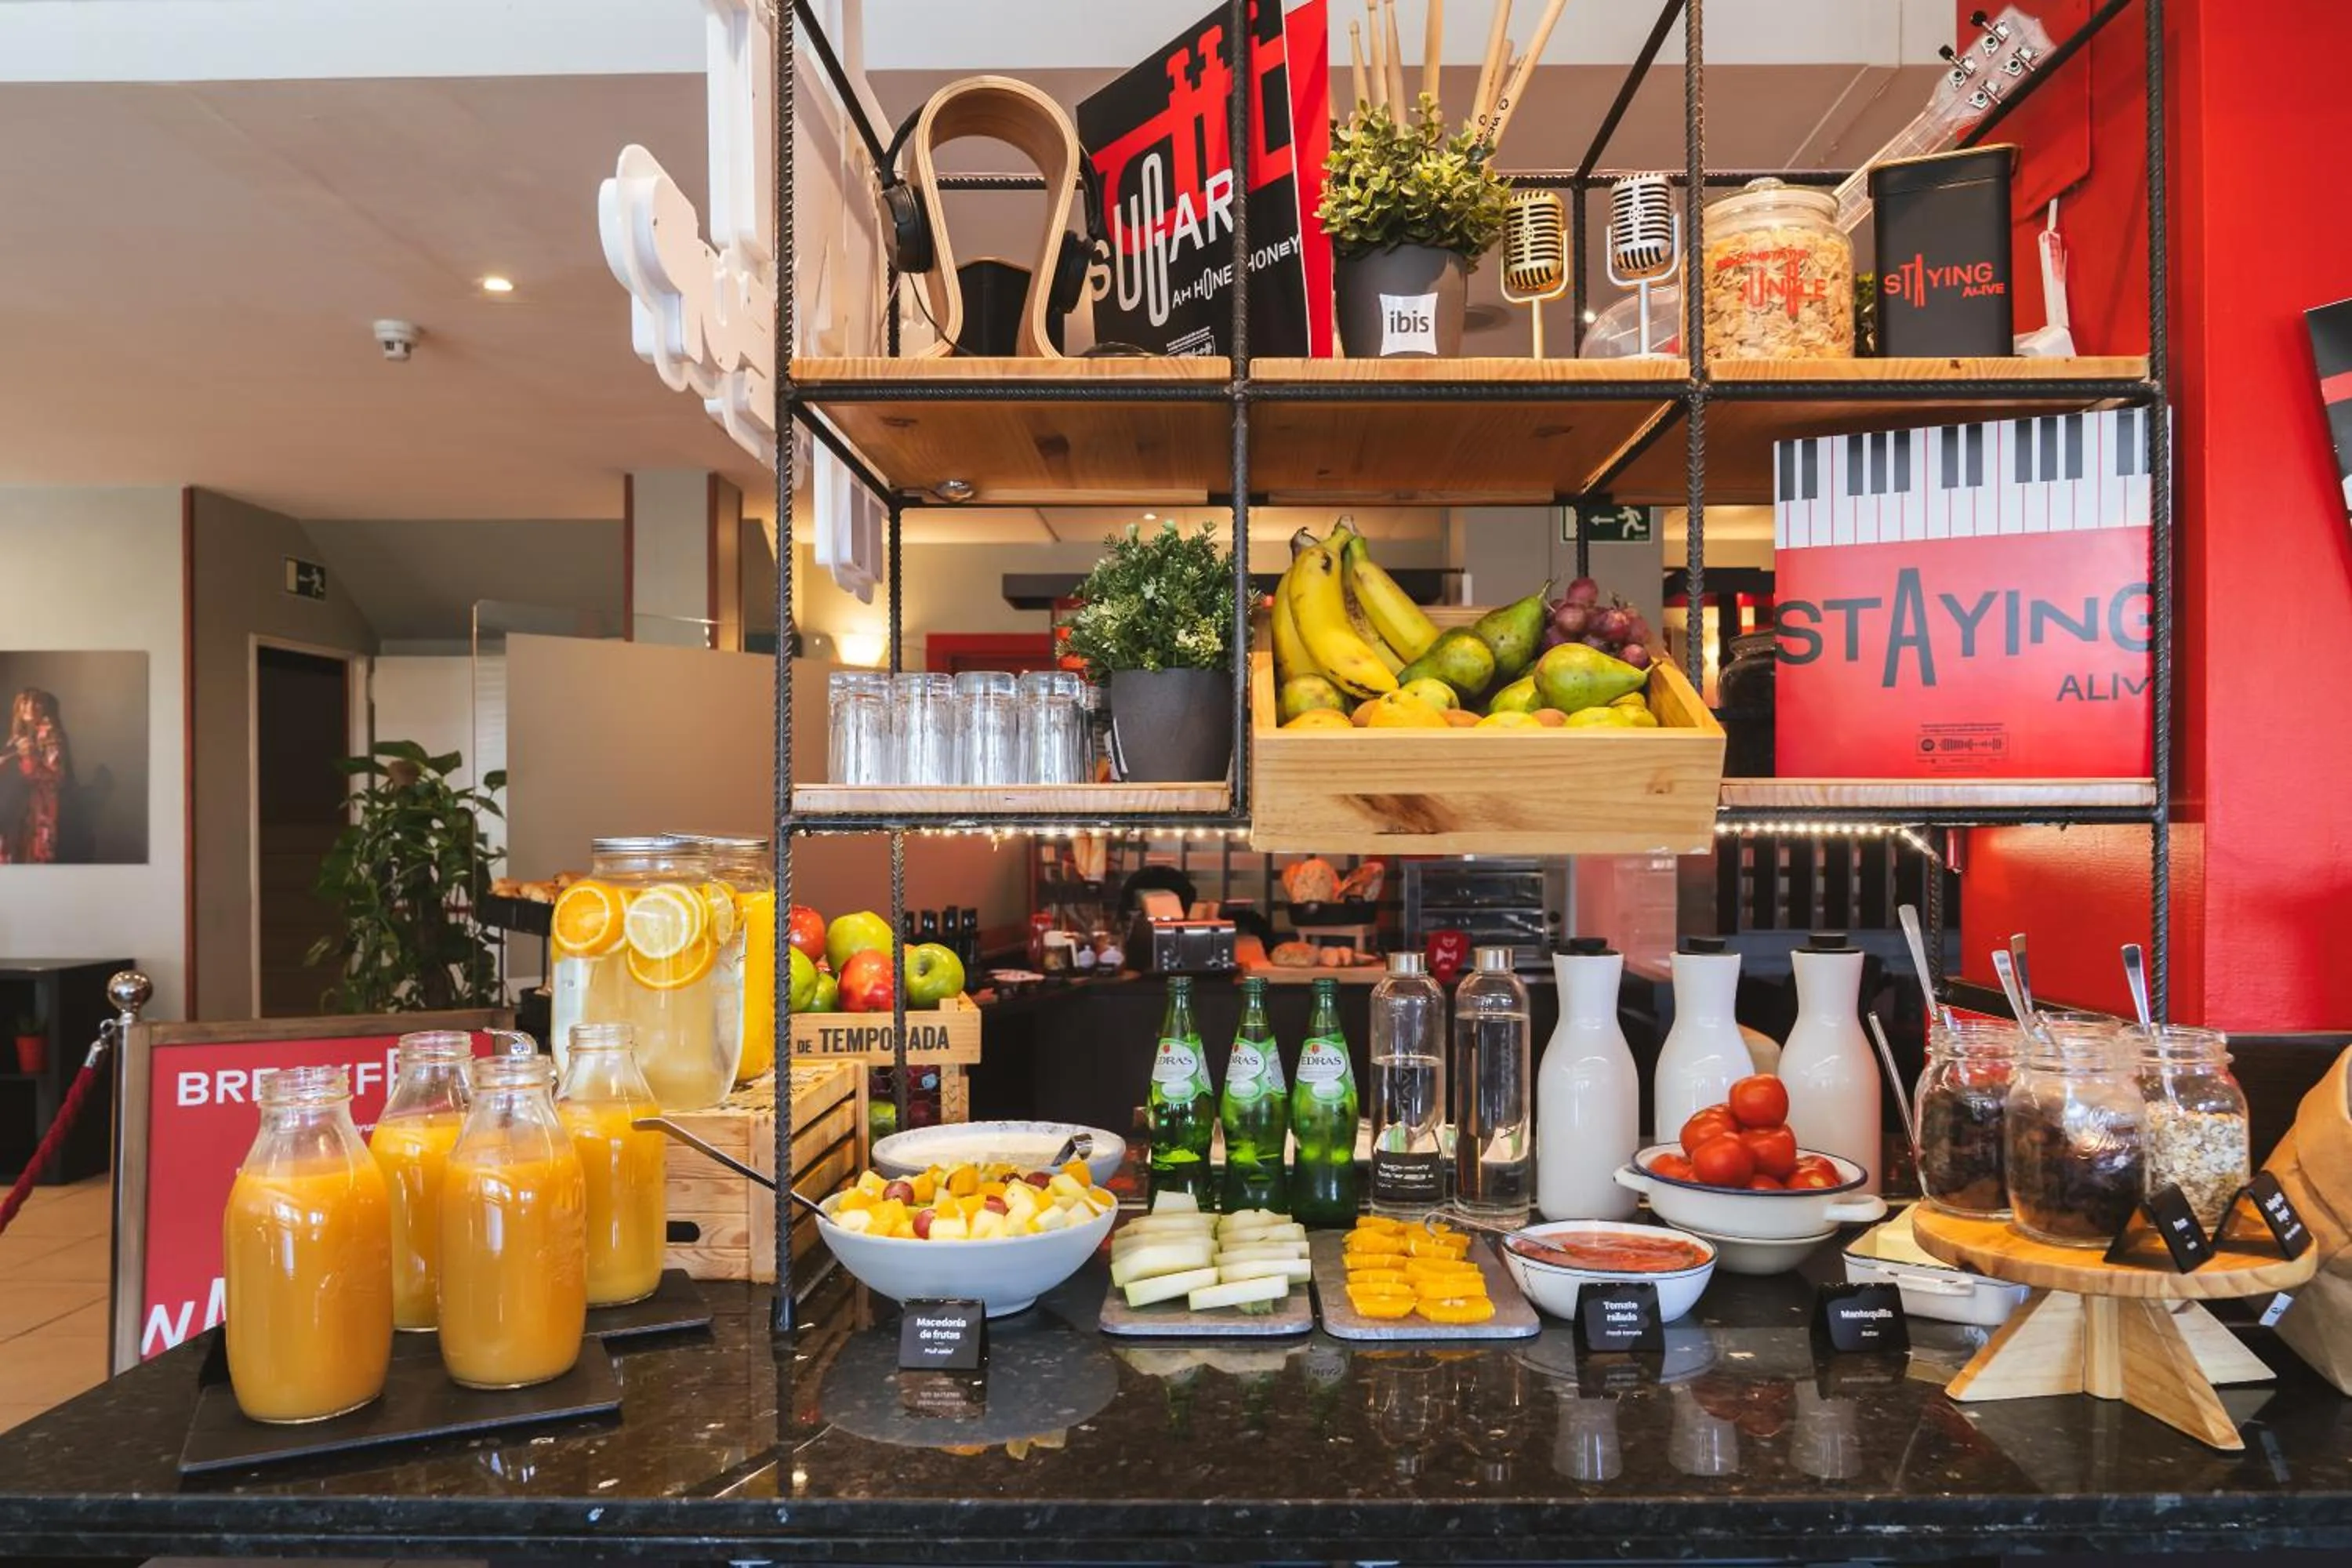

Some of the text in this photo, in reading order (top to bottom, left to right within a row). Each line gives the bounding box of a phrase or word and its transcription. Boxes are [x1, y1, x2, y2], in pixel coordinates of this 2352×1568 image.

[1087, 153, 1233, 326] SUGAR
[1172, 286, 1192, 309] AH
[1193, 265, 1235, 300] HONE
[1883, 253, 1994, 307] STAYING
[1962, 282, 2006, 298] ALIVE
[1390, 310, 1429, 335] ibis
[2056, 673, 2153, 701] ALIV
[797, 1025, 950, 1054] DE TEMPOADA
[1603, 1301, 1638, 1310] Tomate
[920, 1330, 960, 1340] de frutas
